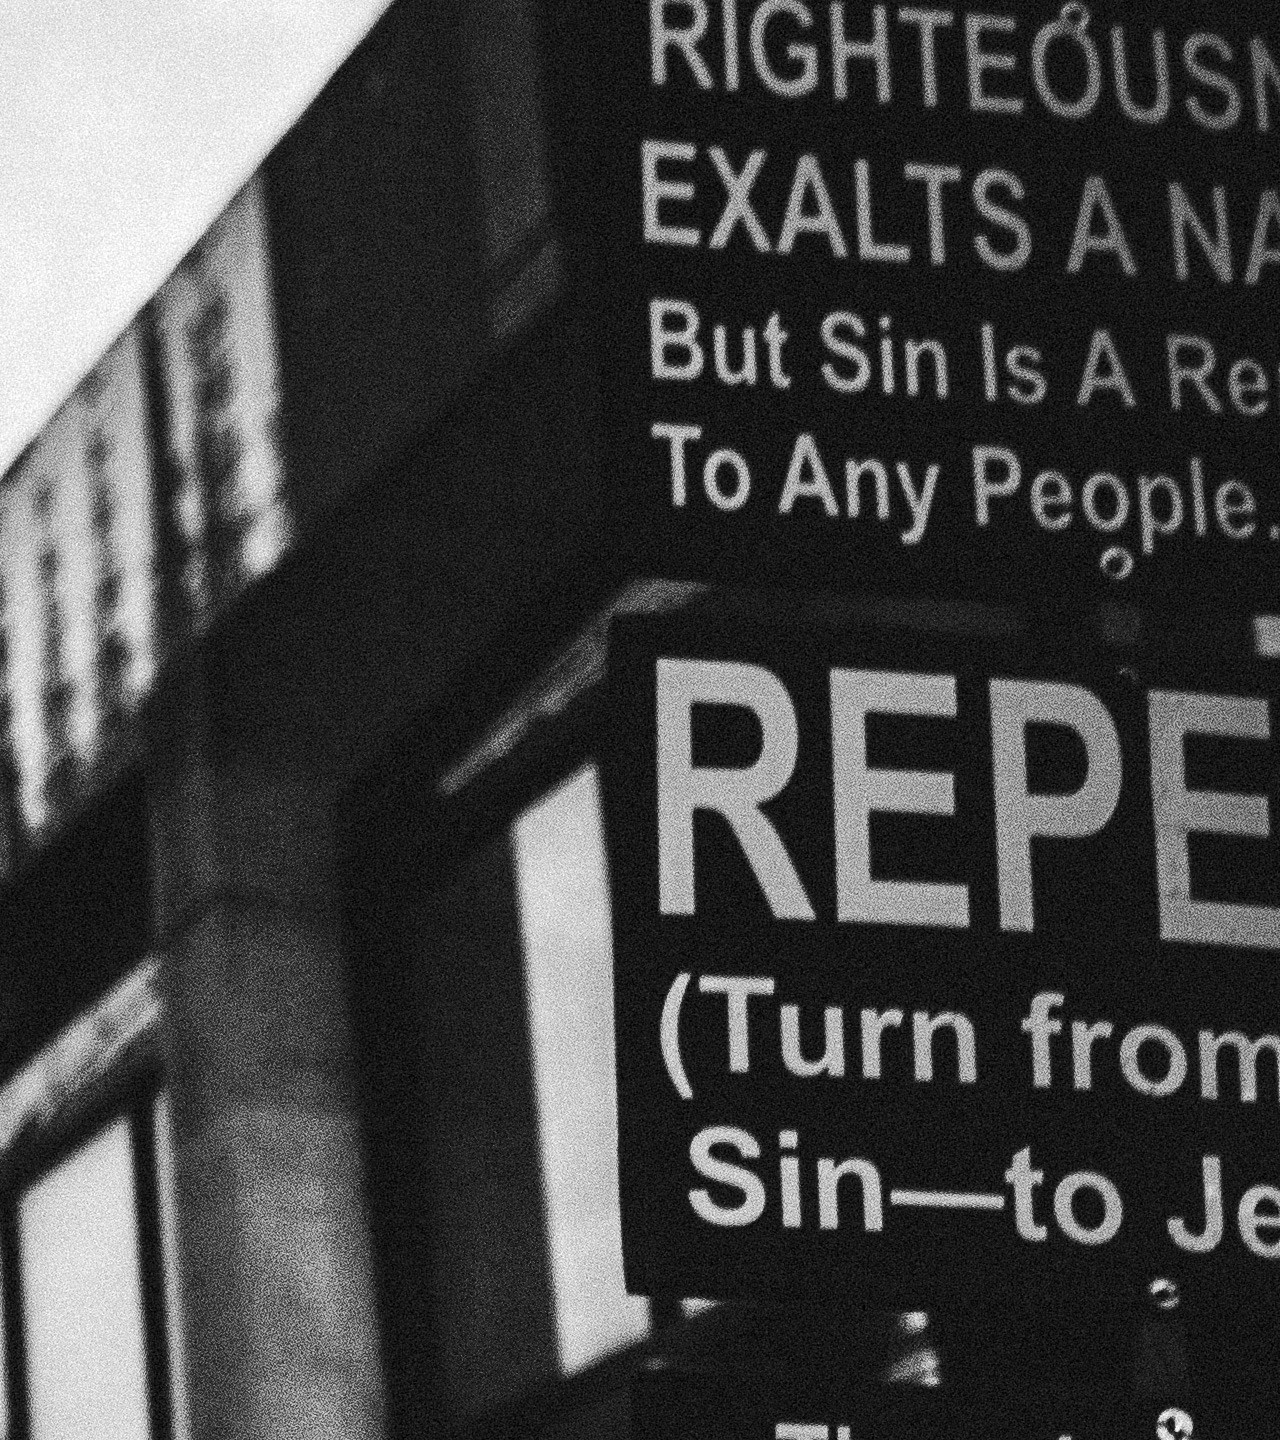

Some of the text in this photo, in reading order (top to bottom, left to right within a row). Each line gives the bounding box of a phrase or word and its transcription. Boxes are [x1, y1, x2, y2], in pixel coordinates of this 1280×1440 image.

[641, 140, 1030, 269] EXALTS
[1067, 176, 1136, 275] A
[650, 299, 1280, 416] But Sin Is A Re
[651, 423, 1280, 555] To Any People.
[656, 657, 1280, 947] REPE
[660, 973, 1280, 1102] (Turn from
[1167, 1156, 1280, 1258] Je
